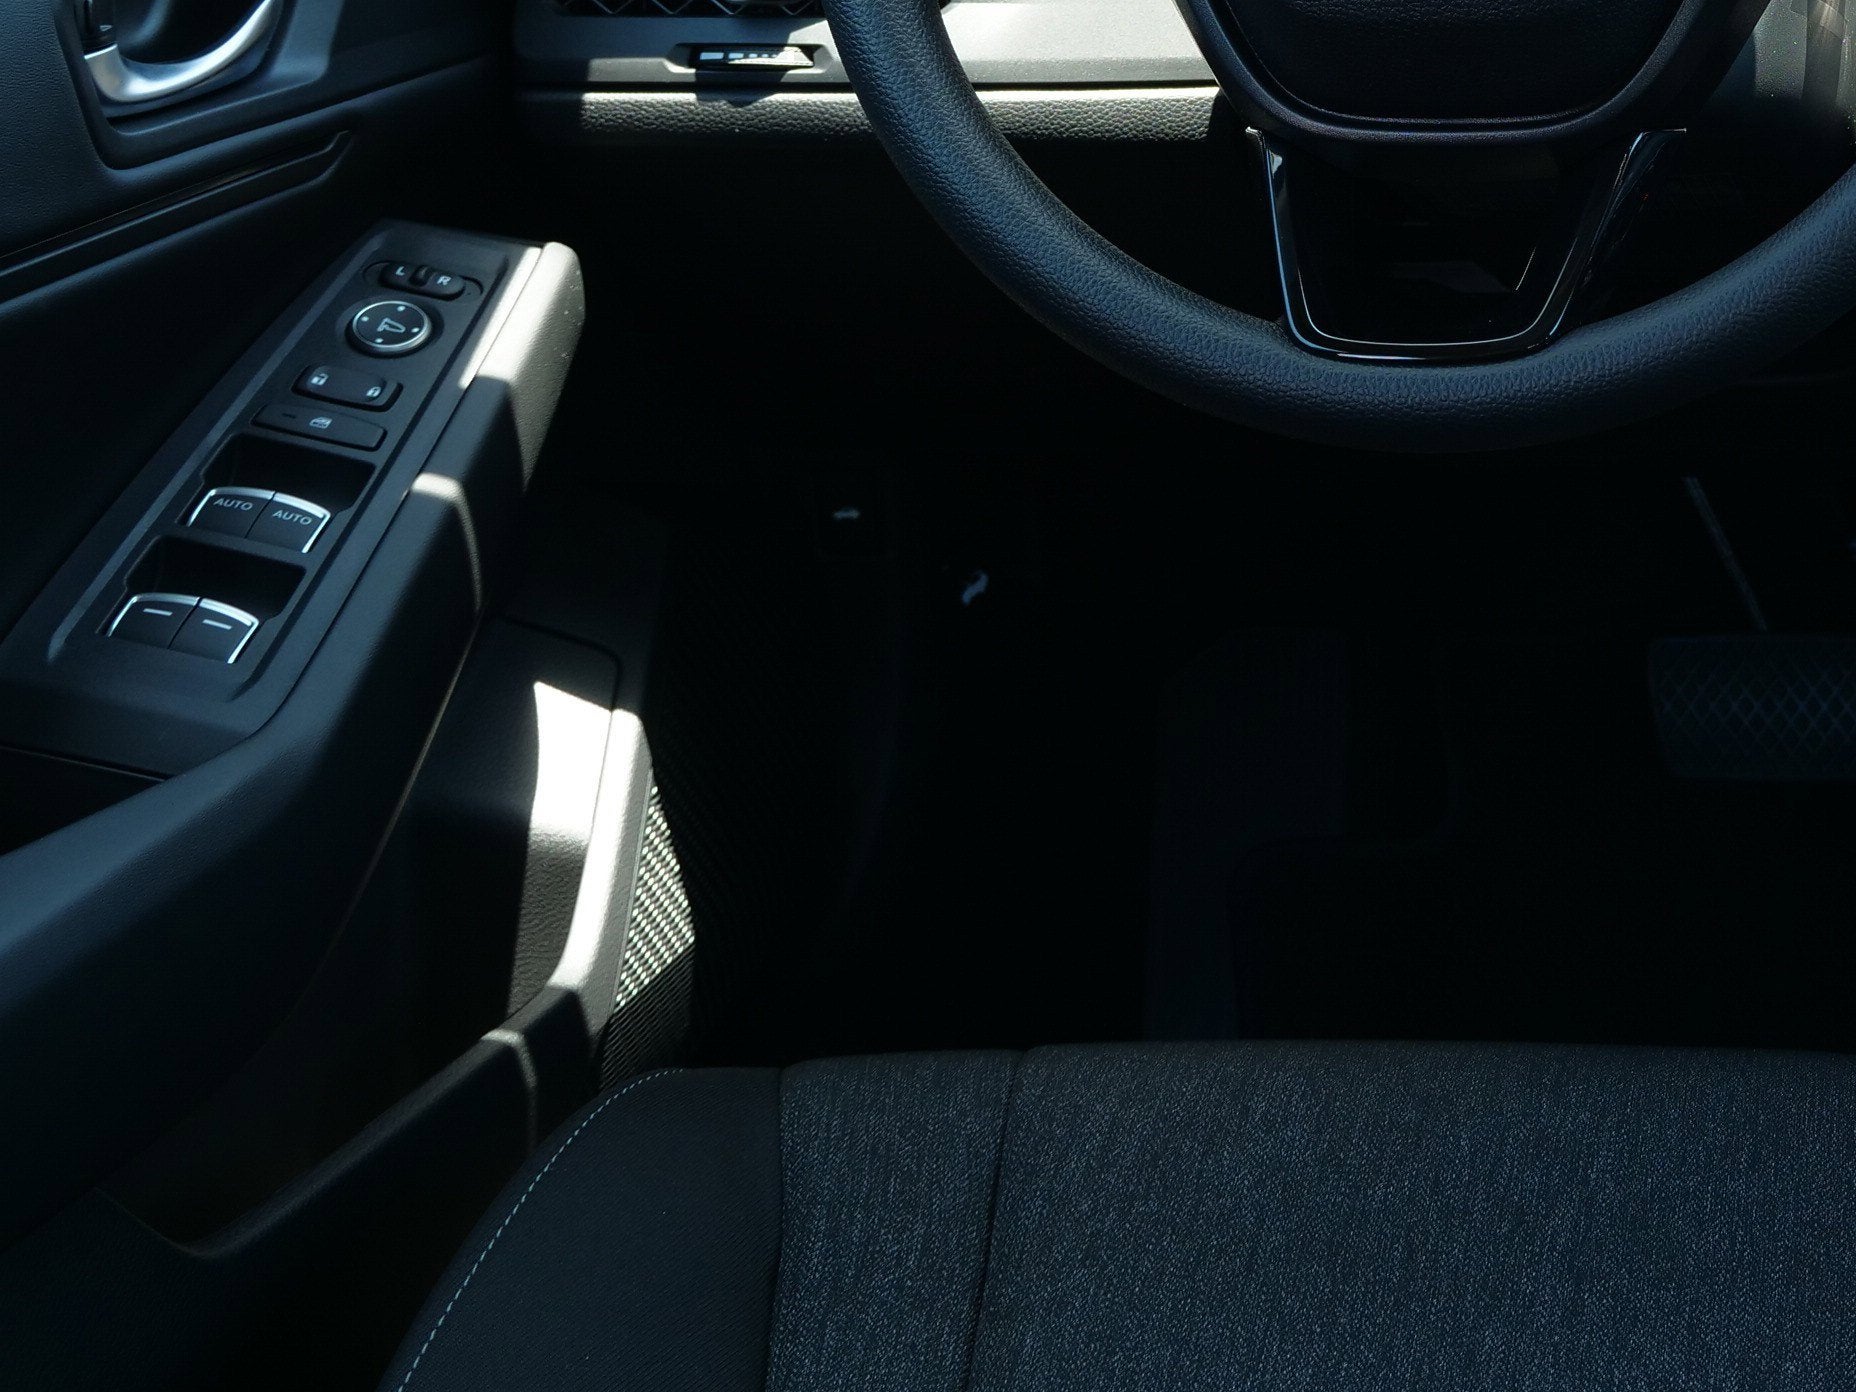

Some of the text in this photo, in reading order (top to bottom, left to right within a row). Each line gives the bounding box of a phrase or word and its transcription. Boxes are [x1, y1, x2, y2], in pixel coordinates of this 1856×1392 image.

[395, 266, 405, 276] L
[437, 275, 451, 285] R
[214, 497, 254, 511] AUTO
[273, 509, 313, 525] AUTO
